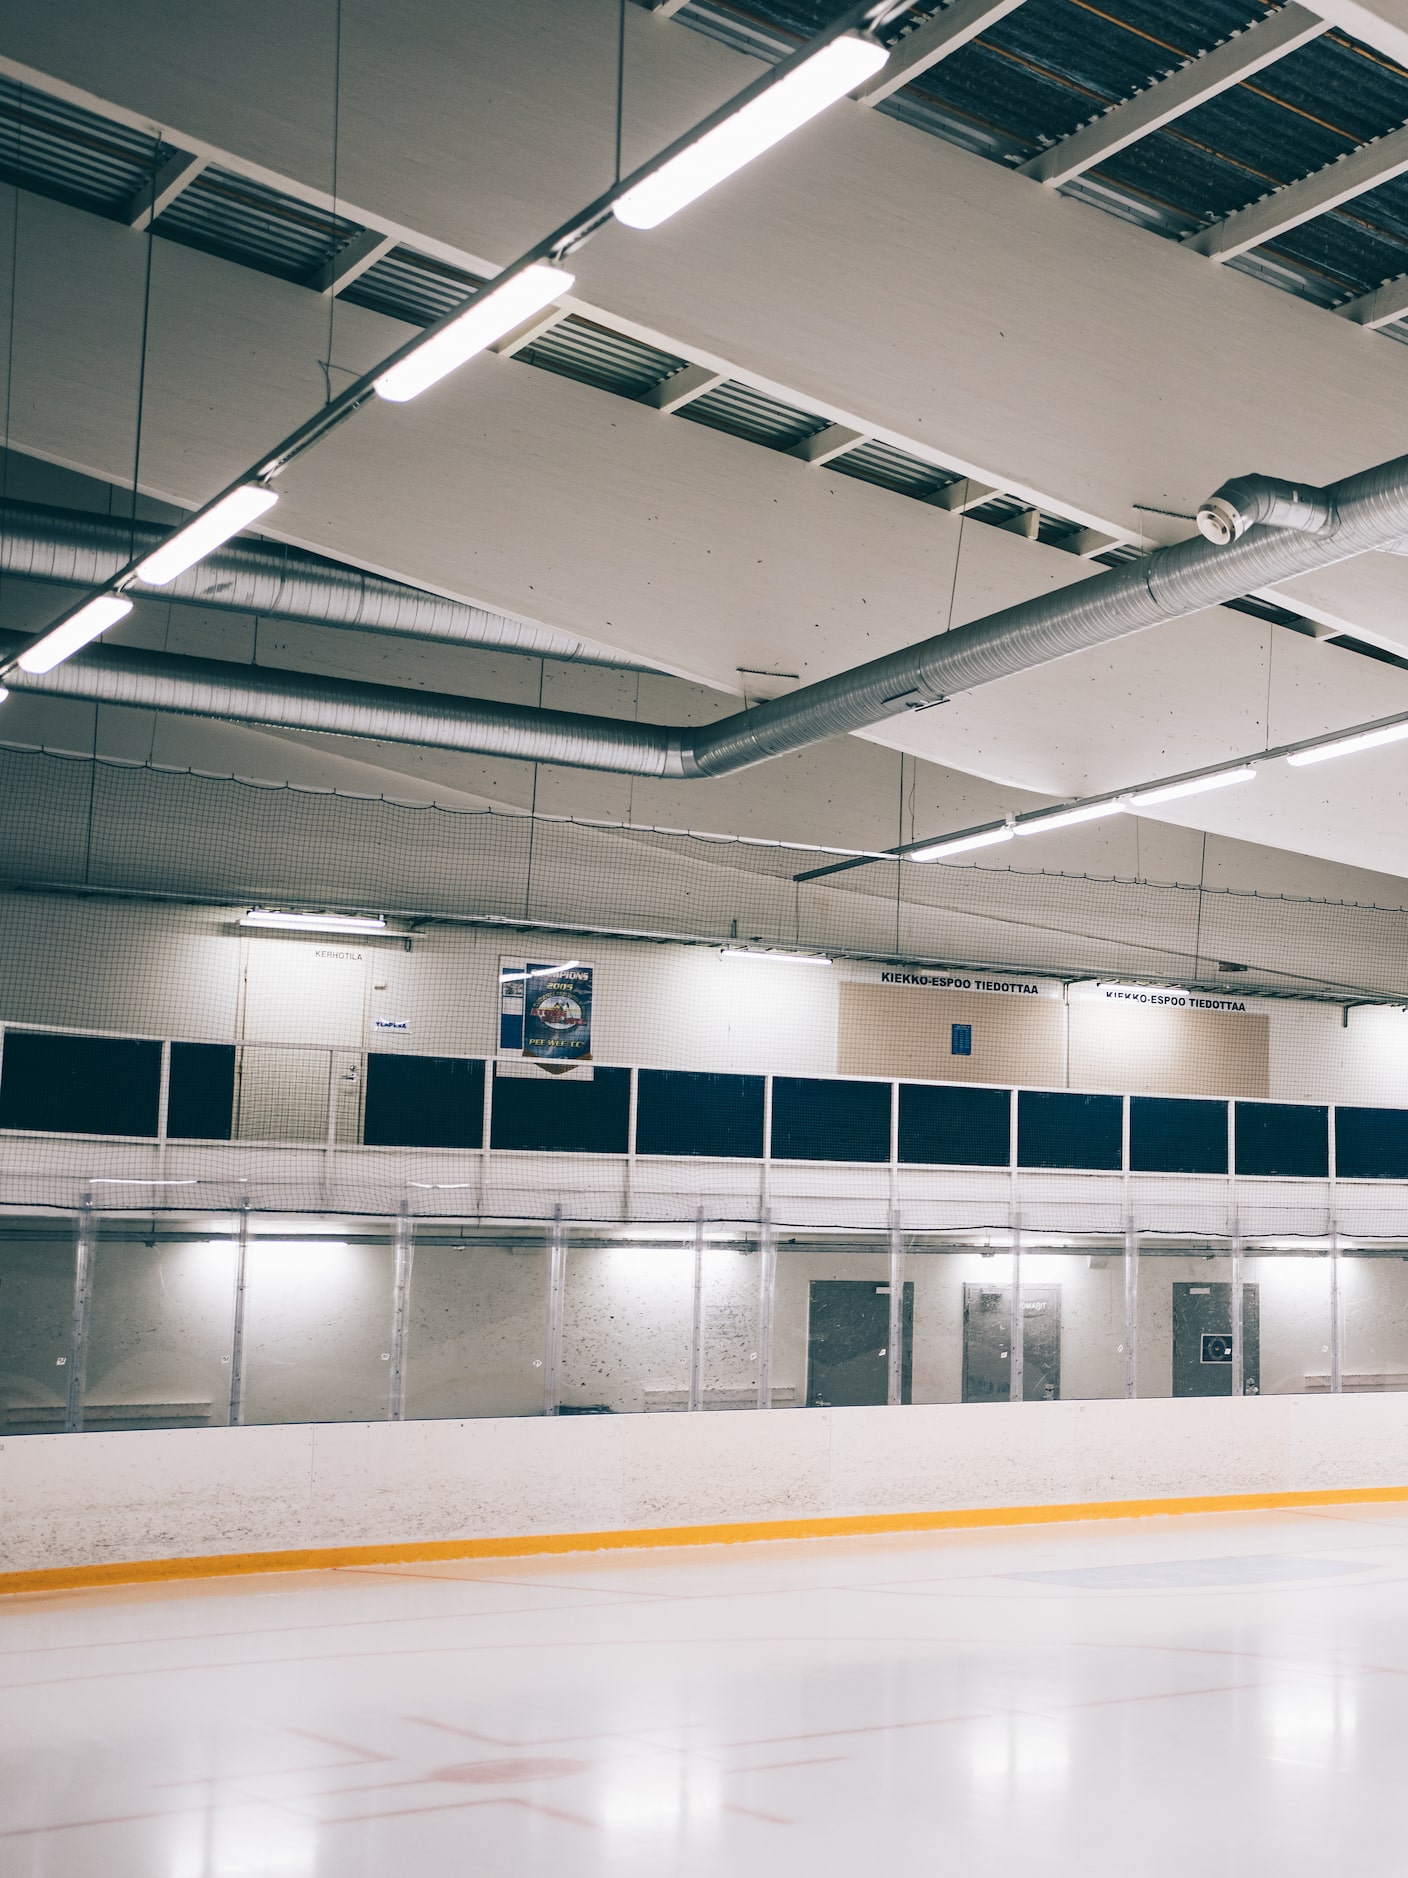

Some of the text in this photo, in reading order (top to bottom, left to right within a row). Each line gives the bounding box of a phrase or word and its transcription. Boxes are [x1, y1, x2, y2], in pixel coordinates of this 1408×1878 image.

[315, 950, 363, 960] KERHOTILA
[881, 972, 1039, 994] KIEKKO-ESPOO TIEDOTTAA
[1188, 998, 1246, 1011] TIEDOTTAA
[529, 1038, 546, 1046] PEE
[547, 1039, 567, 1047] WEE
